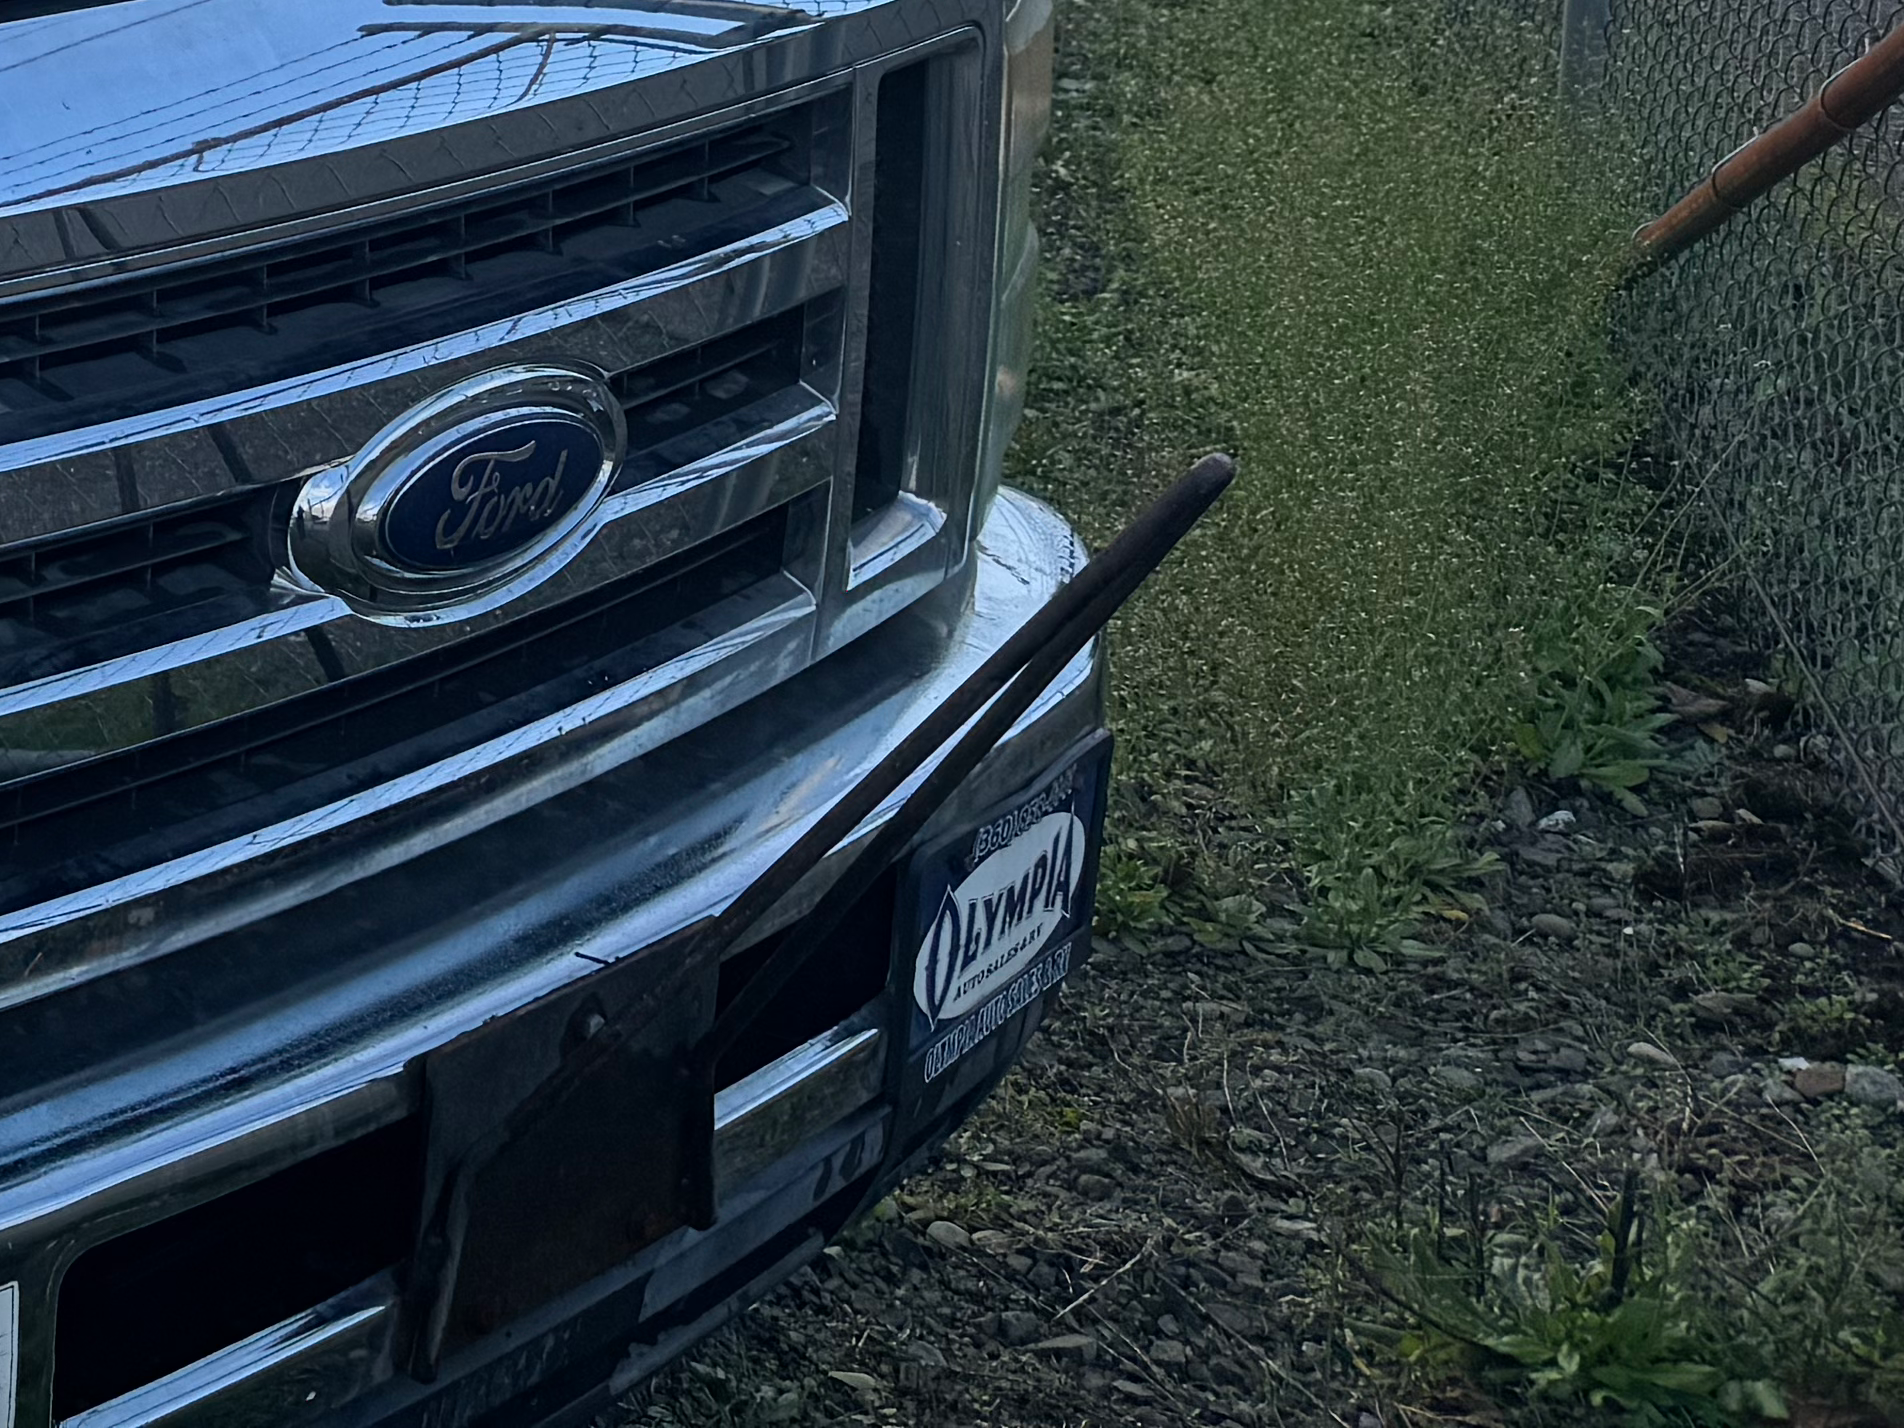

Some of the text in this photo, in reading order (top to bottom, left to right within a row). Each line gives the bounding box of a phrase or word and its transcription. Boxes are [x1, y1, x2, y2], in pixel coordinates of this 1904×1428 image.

[434, 440, 569, 550] Ford
[924, 799, 1076, 1031] OLYMPIA
[953, 971, 986, 1003] AUTO
[986, 941, 1020, 981] SALES
[976, 992, 1010, 1044] AUTO
